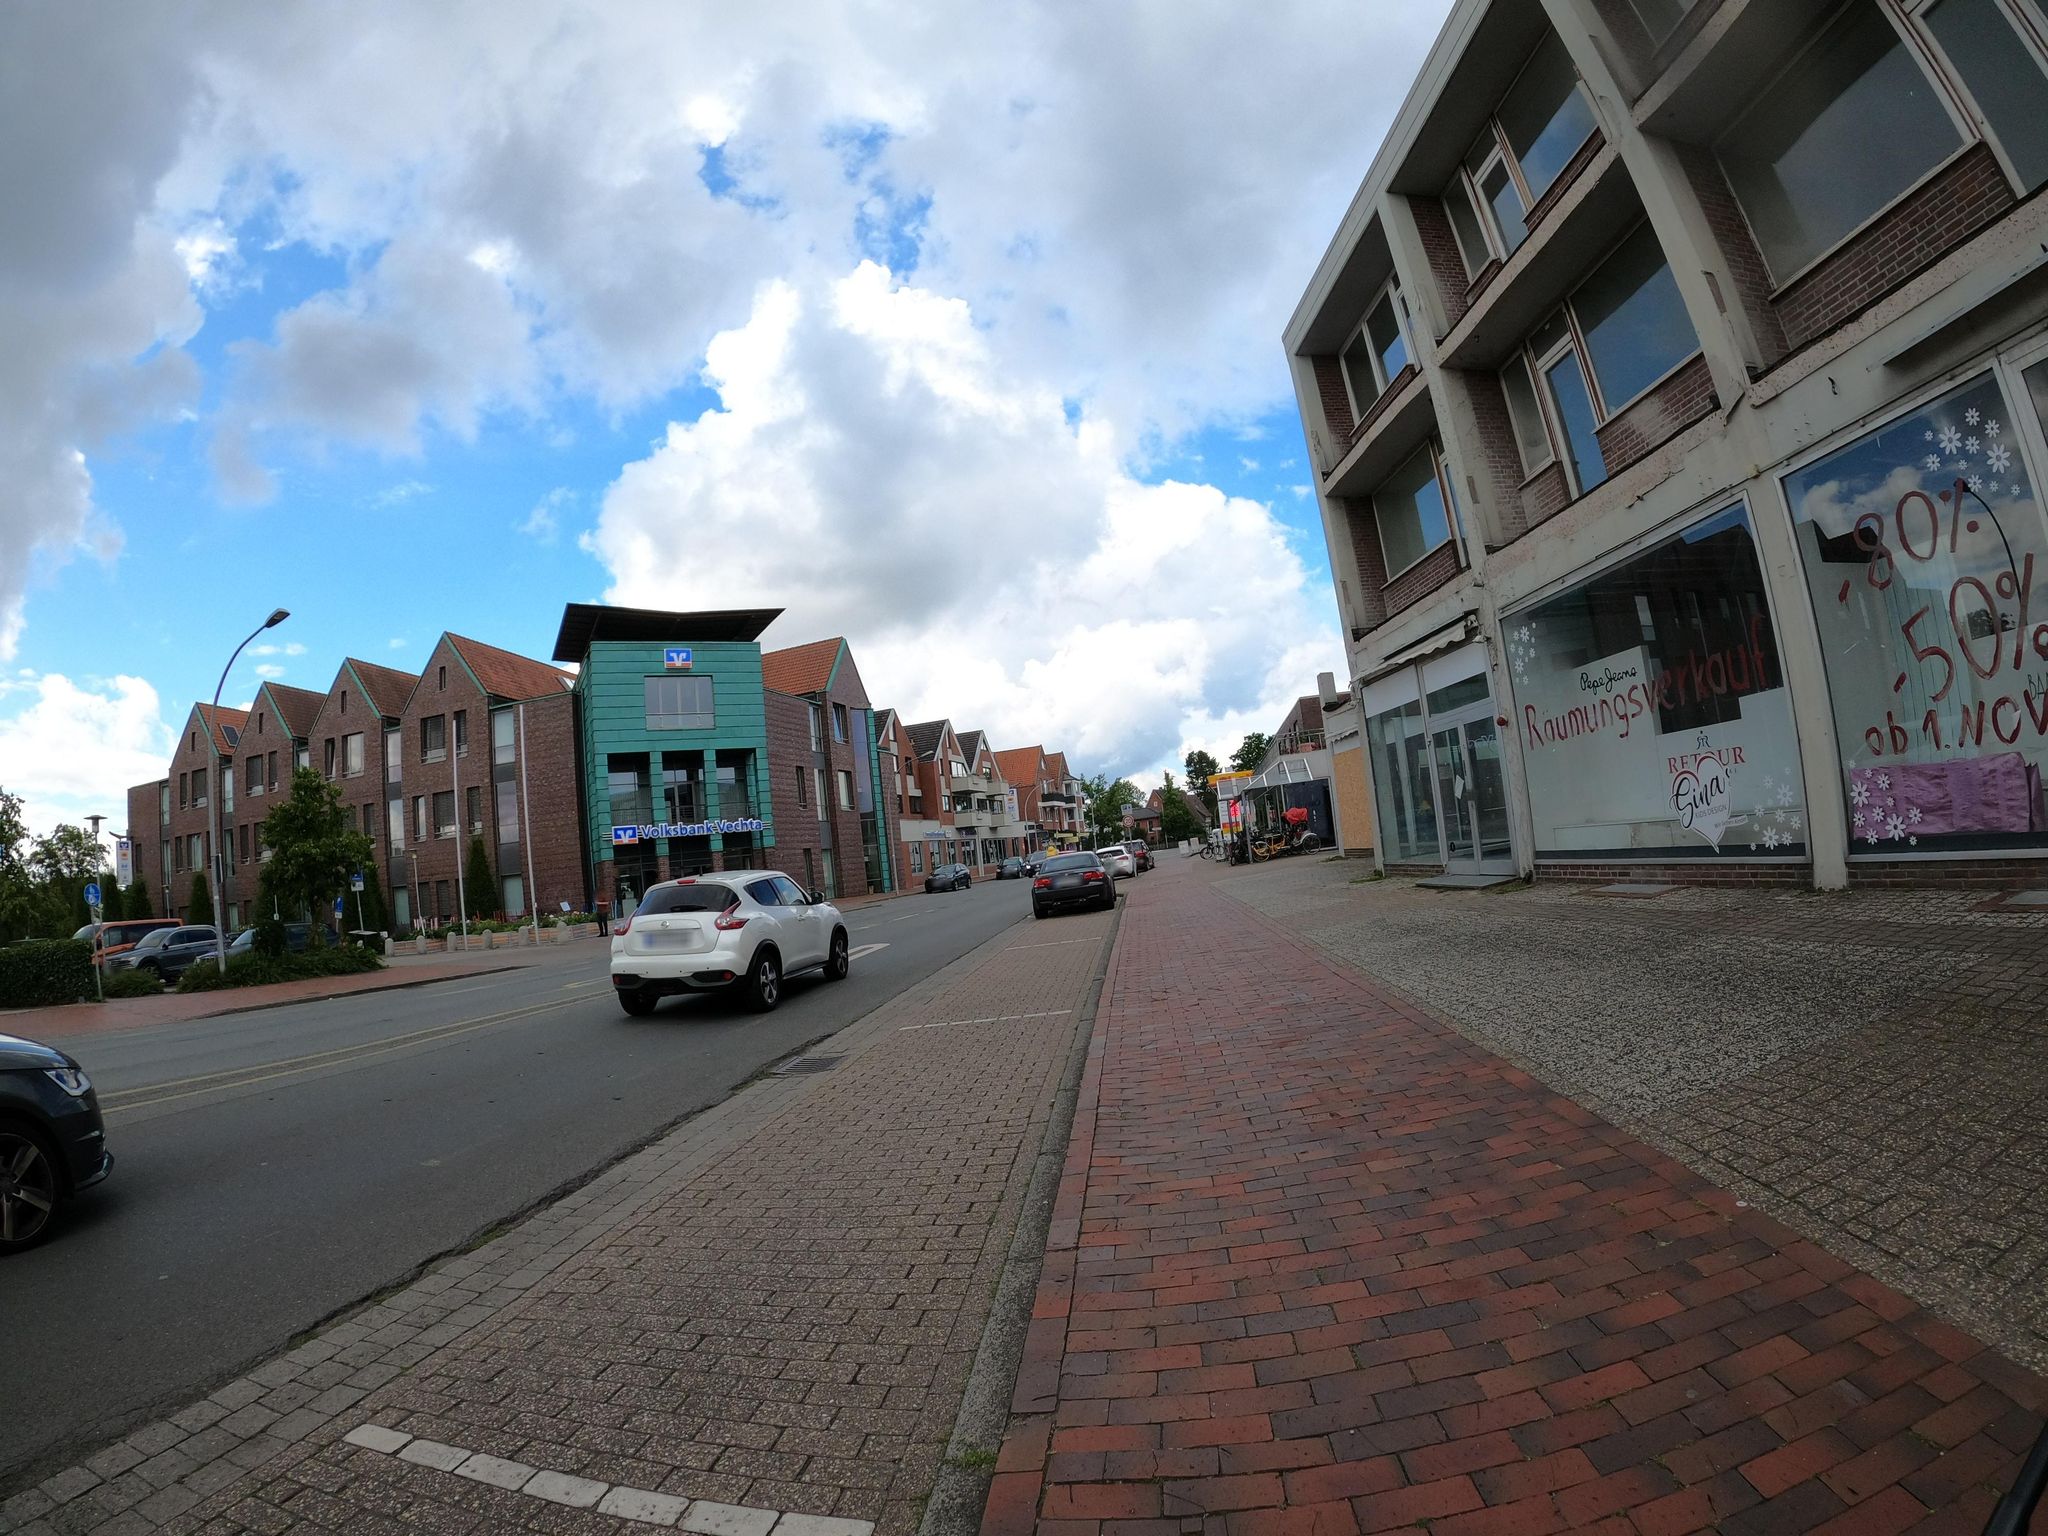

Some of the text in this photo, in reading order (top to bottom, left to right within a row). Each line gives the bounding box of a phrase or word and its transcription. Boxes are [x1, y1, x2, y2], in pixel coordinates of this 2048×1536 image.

[1580, 667, 1637, 695] Pepe Jeans
[640, 818, 763, 838] Volksbank Vechta
